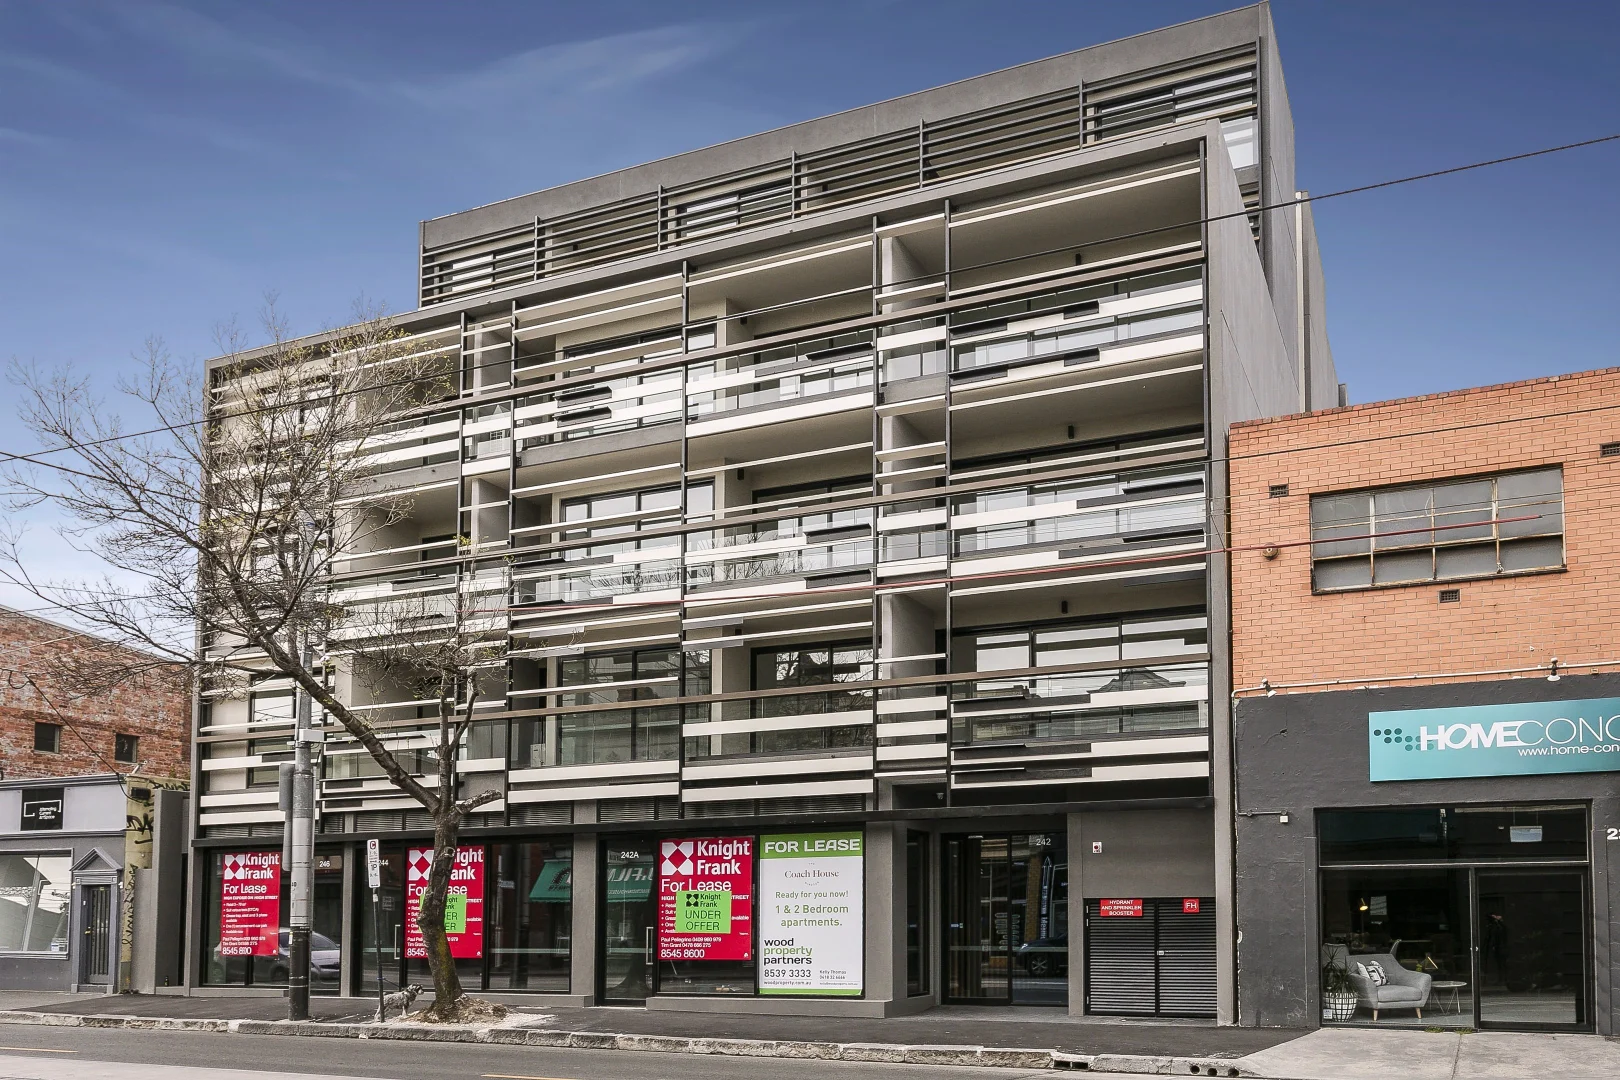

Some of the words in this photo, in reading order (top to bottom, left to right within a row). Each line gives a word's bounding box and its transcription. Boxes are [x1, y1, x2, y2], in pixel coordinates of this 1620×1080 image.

[1518, 743, 1620, 757] www.home-con
[1607, 827, 1620, 840] 2
[764, 840, 799, 854] FOR
[804, 838, 861, 852] LEASE
[1036, 837, 1051, 846] 242
[620, 851, 639, 859] 242A
[697, 840, 750, 860] Knight
[245, 853, 280, 868] Knight
[455, 848, 484, 867] ight
[697, 859, 742, 875] Frank
[245, 867, 274, 880] Frank
[450, 866, 476, 880] ank
[784, 870, 811, 878] Coach
[813, 869, 840, 878] House
[223, 883, 240, 894] For
[240, 883, 268, 894] Lease
[448, 885, 468, 895] ase
[661, 878, 685, 892] For
[688, 878, 732, 891] Lease
[700, 893, 721, 901] Knight
[775, 891, 799, 899] Ready
[800, 890, 812, 898] for
[829, 890, 849, 898] now!
[775, 905, 780, 913] 1
[783, 904, 791, 914] &
[794, 904, 800, 913] 2
[802, 904, 849, 913] Bedroom
[685, 910, 721, 919] UNDER
[685, 921, 720, 931] OFFER
[780, 918, 843, 928] apartments.
[764, 938, 794, 947] wood
[222, 947, 238, 955] 8545
[407, 948, 425, 956] 8545
[661, 949, 682, 958] 8545
[683, 949, 705, 958] 8600
[764, 946, 812, 957] property
[764, 956, 812, 966] partners
[764, 969, 786, 978] 8539
[788, 969, 811, 978] 3333
